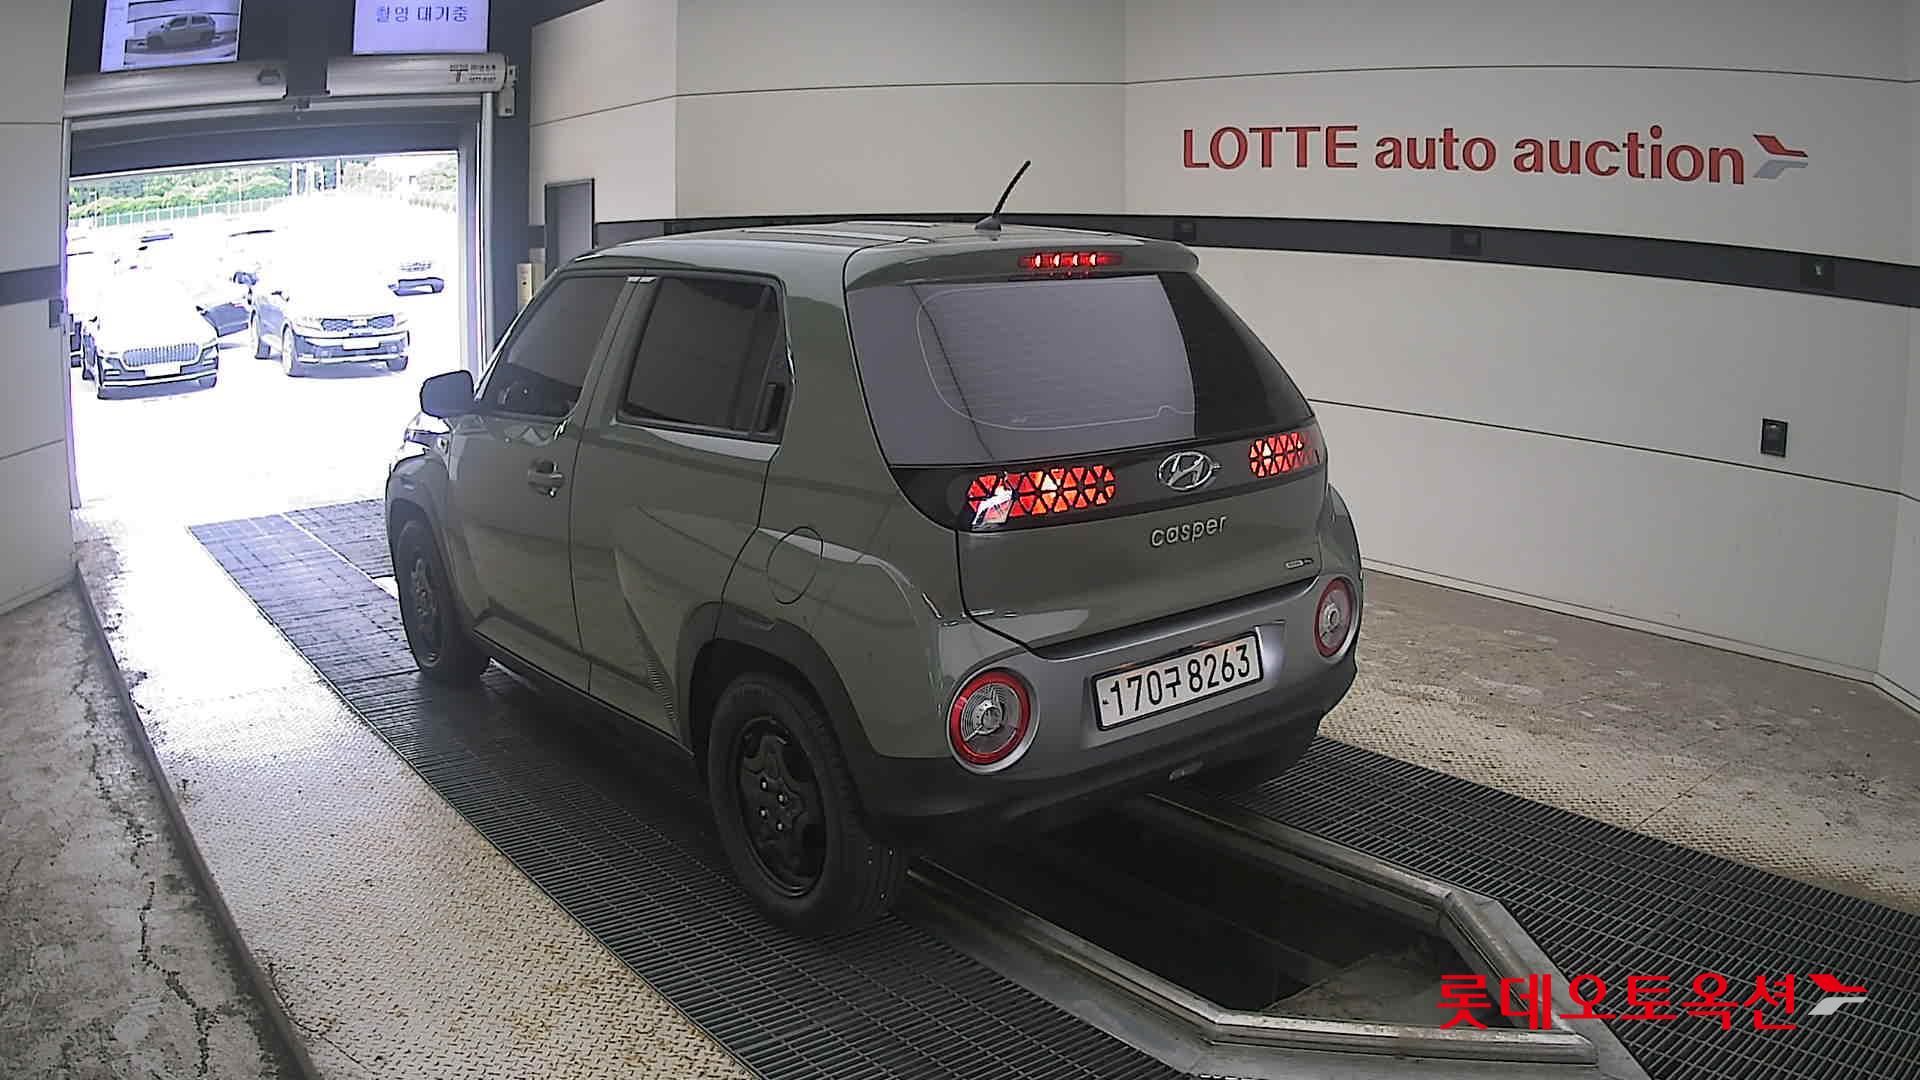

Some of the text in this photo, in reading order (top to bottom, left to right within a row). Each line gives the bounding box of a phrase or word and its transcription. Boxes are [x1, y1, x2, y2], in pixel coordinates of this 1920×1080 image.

[417, 5, 468, 23] 대기중
[1183, 124, 1745, 185] LOTTE auto auction
[1151, 516, 1227, 547] casper
[1187, 644, 1250, 693] 8263
